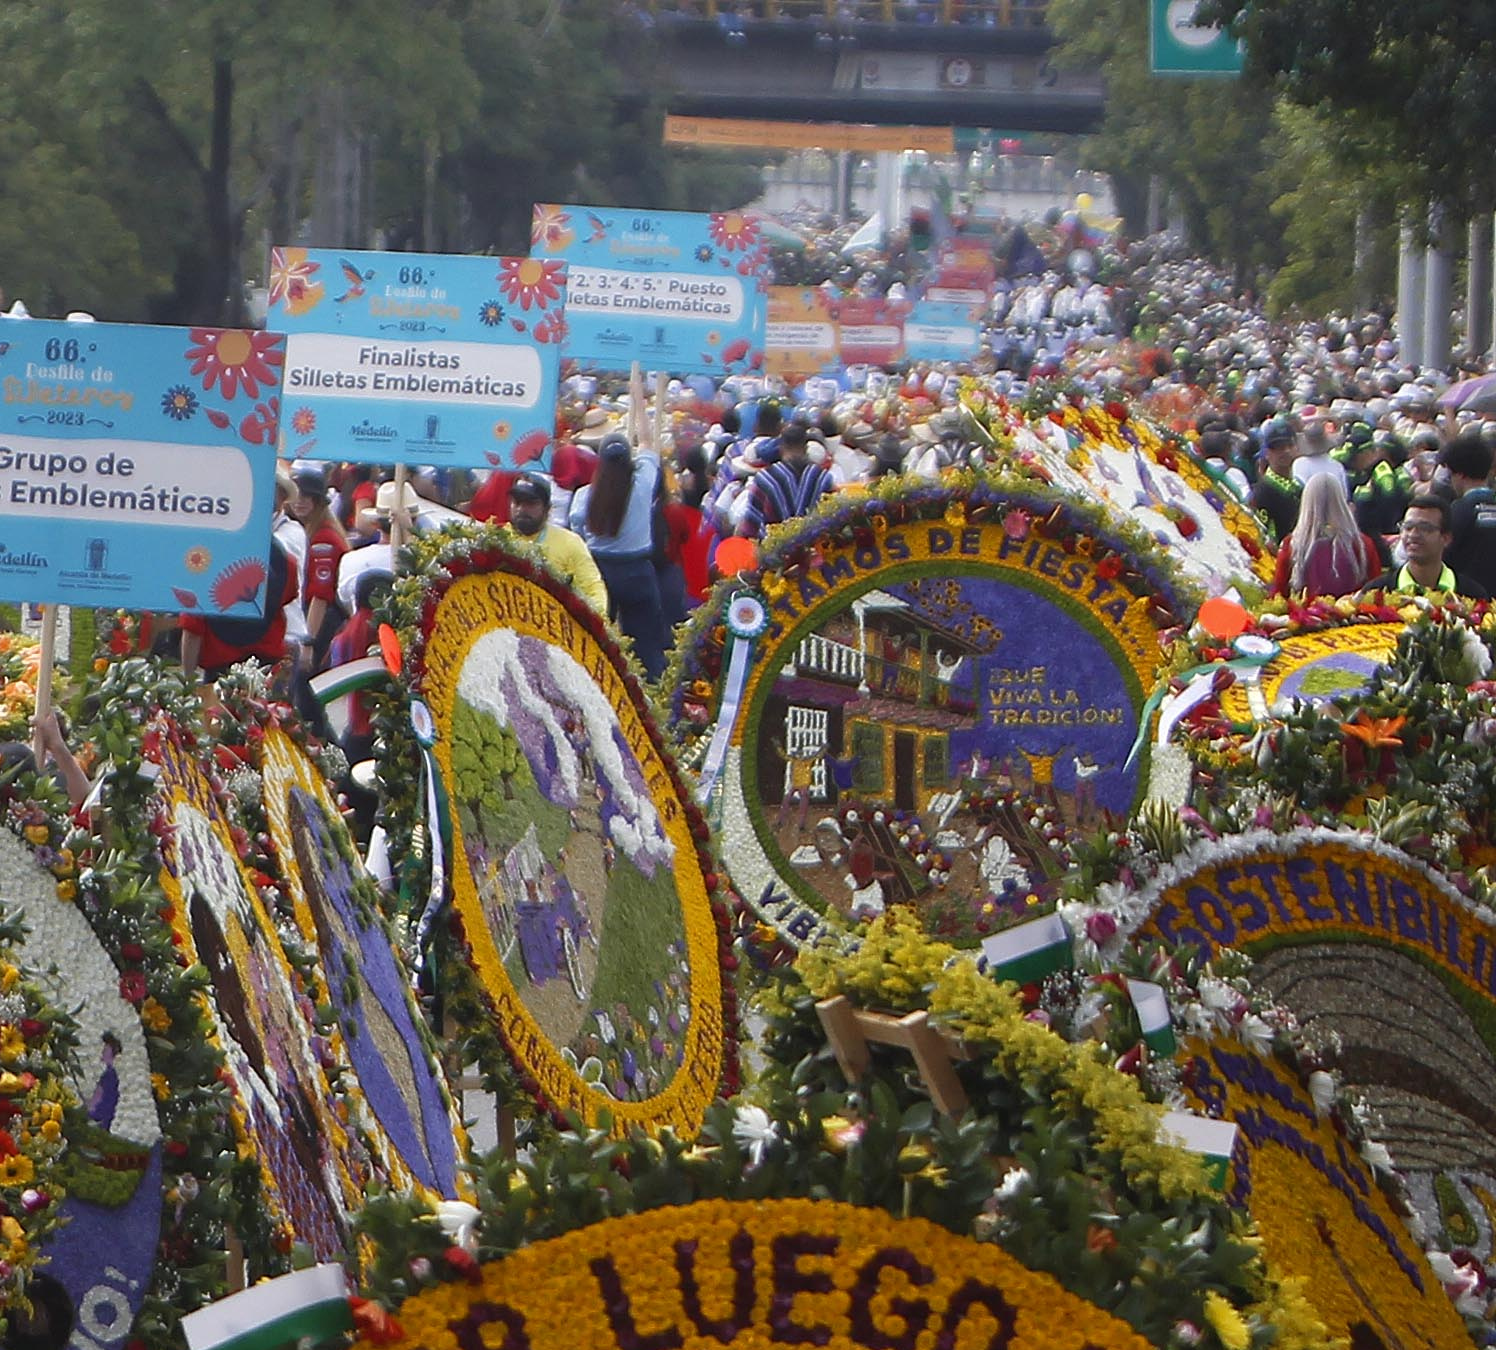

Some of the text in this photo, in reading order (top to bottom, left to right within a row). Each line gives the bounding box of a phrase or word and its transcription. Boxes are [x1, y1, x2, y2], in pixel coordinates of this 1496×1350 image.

[669, 279, 727, 296] Puesto
[613, 295, 732, 314] Emblemáticas
[399, 321, 426, 333] 2023
[359, 345, 461, 370] Finalistas
[25, 362, 114, 383] Desfile de
[290, 366, 526, 397] Silletas Emblemáticas
[46, 410, 85, 427] 2023
[95, 451, 135, 476] de
[11, 479, 231, 516] Emblemáticas
[928, 525, 983, 557] DE
[990, 688, 1080, 707] VIVA LA
